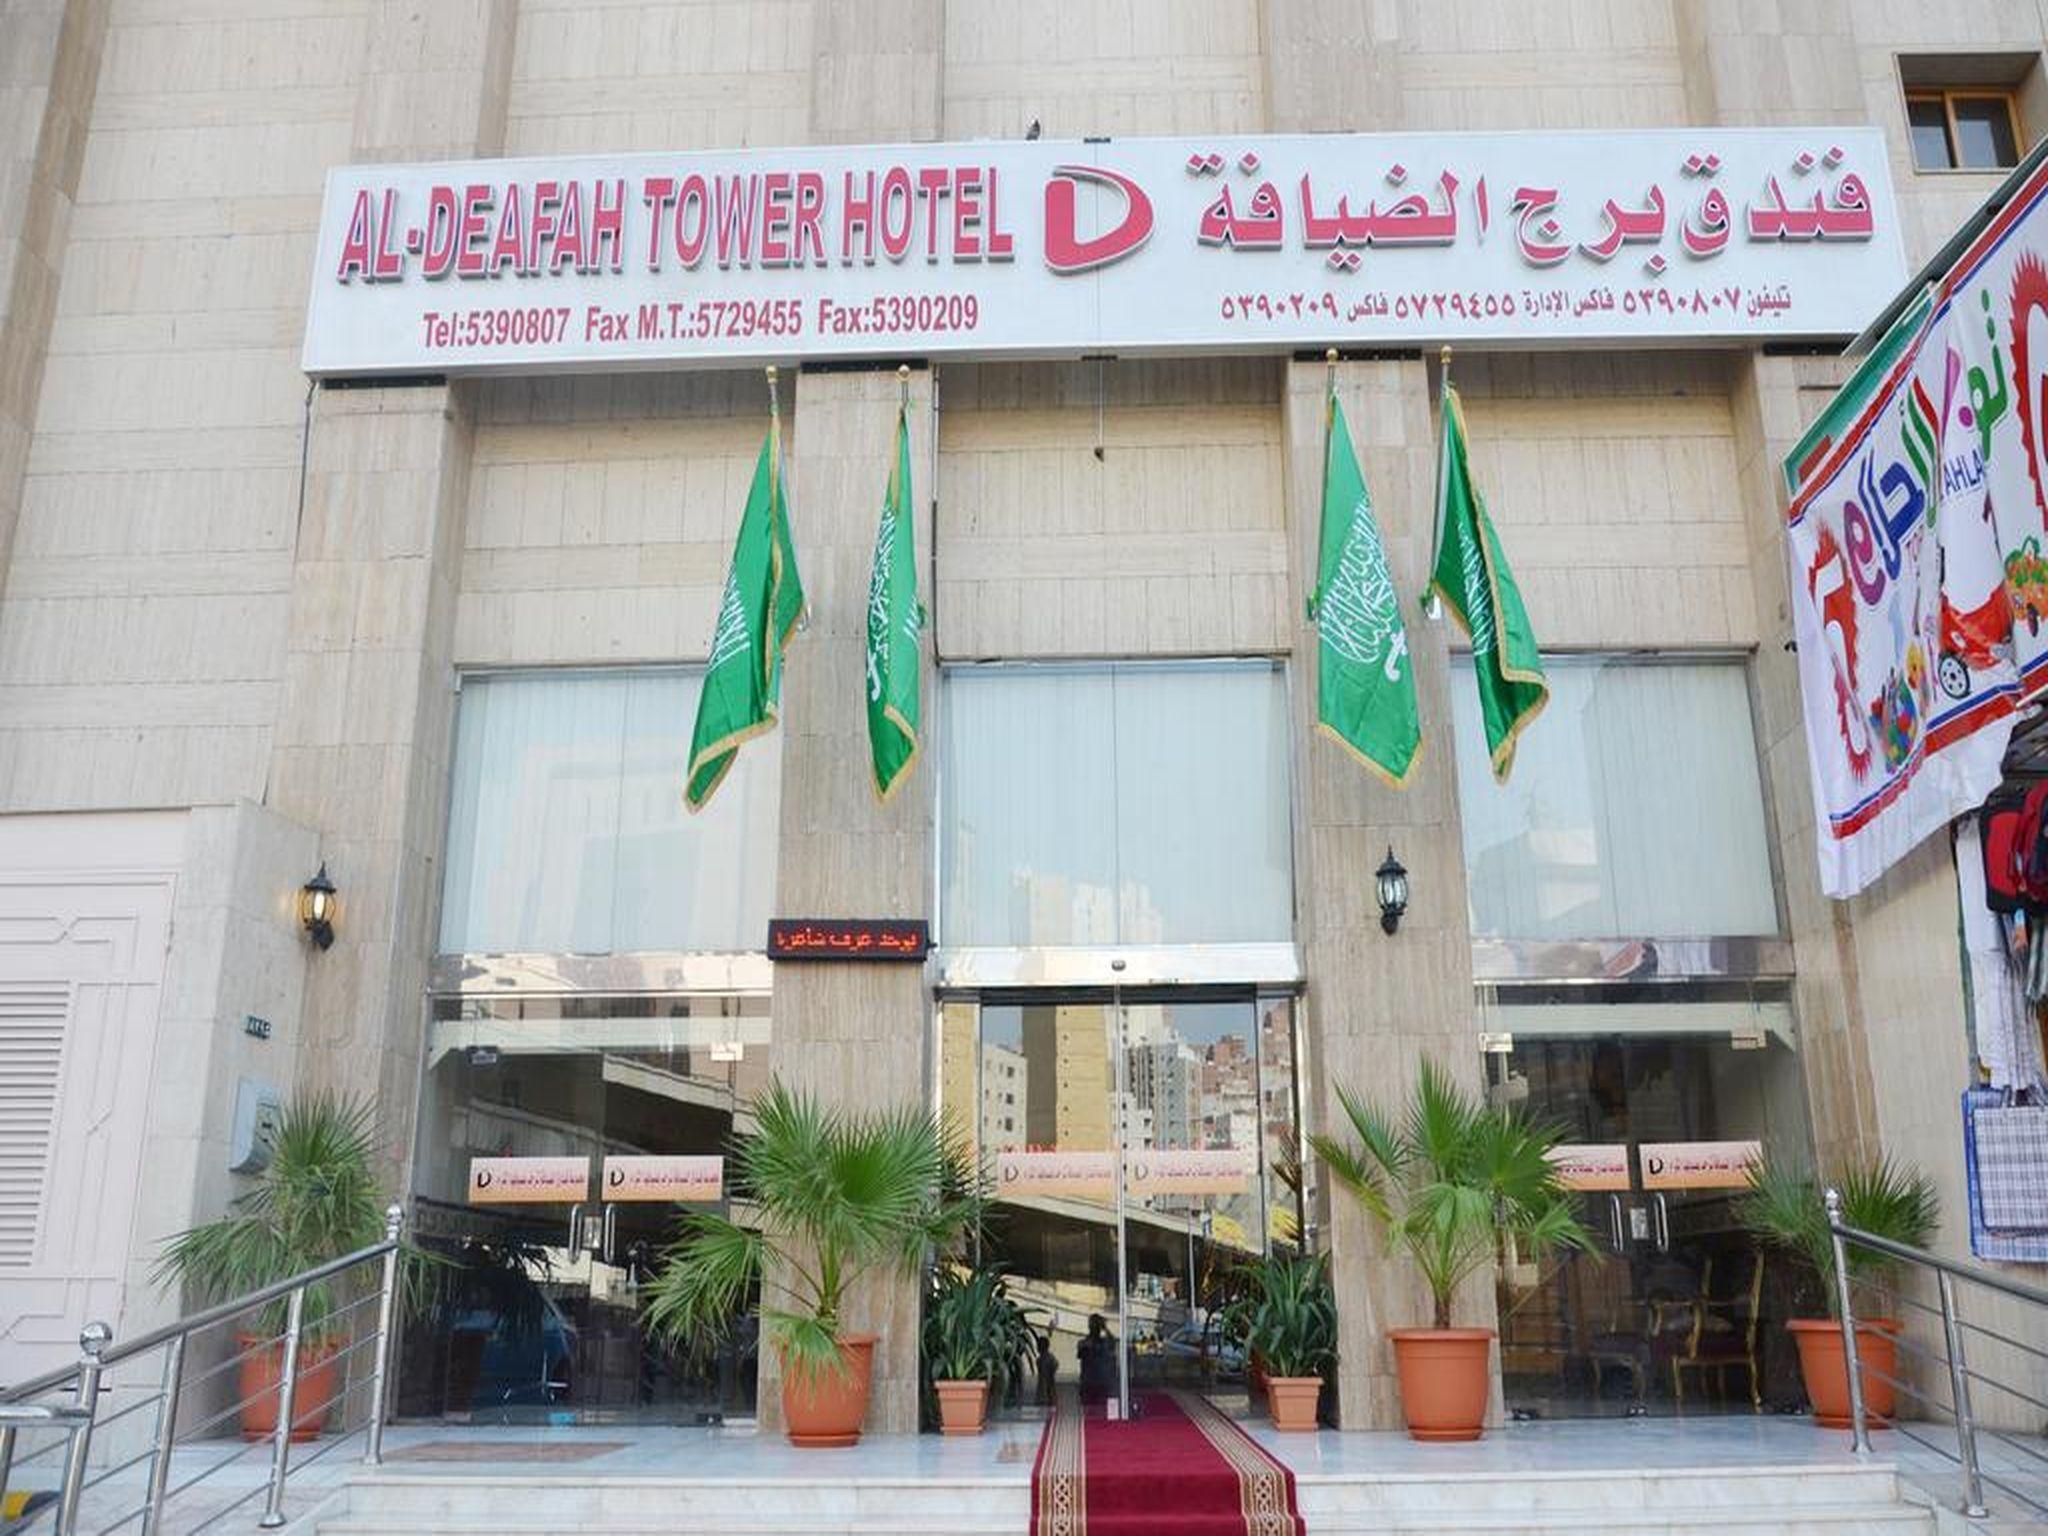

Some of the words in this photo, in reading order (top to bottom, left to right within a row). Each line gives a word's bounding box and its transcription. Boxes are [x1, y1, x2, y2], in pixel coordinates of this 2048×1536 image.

[1185, 150, 1490, 276] الضيافة
[1680, 144, 1874, 258] فندق
[338, 179, 626, 284] AL-DEAFAH
[643, 171, 828, 273] TOWER
[840, 166, 1016, 268] HOTEL
[1511, 184, 1669, 278] برج
[423, 308, 571, 347] Tel:5390807
[585, 305, 629, 342] Fax
[637, 300, 802, 340] M.T.:5729455
[818, 294, 979, 334] Fax:5390209
[1221, 292, 1338, 320] ٥٣٩٠٢٠٩
[1348, 292, 1389, 322] فاكس
[1395, 290, 1516, 319] ٥٧٢٩٤٥٥
[1573, 287, 1615, 317] فاكس
[1623, 286, 1741, 314] ٥٣٩٠٨٠٧
